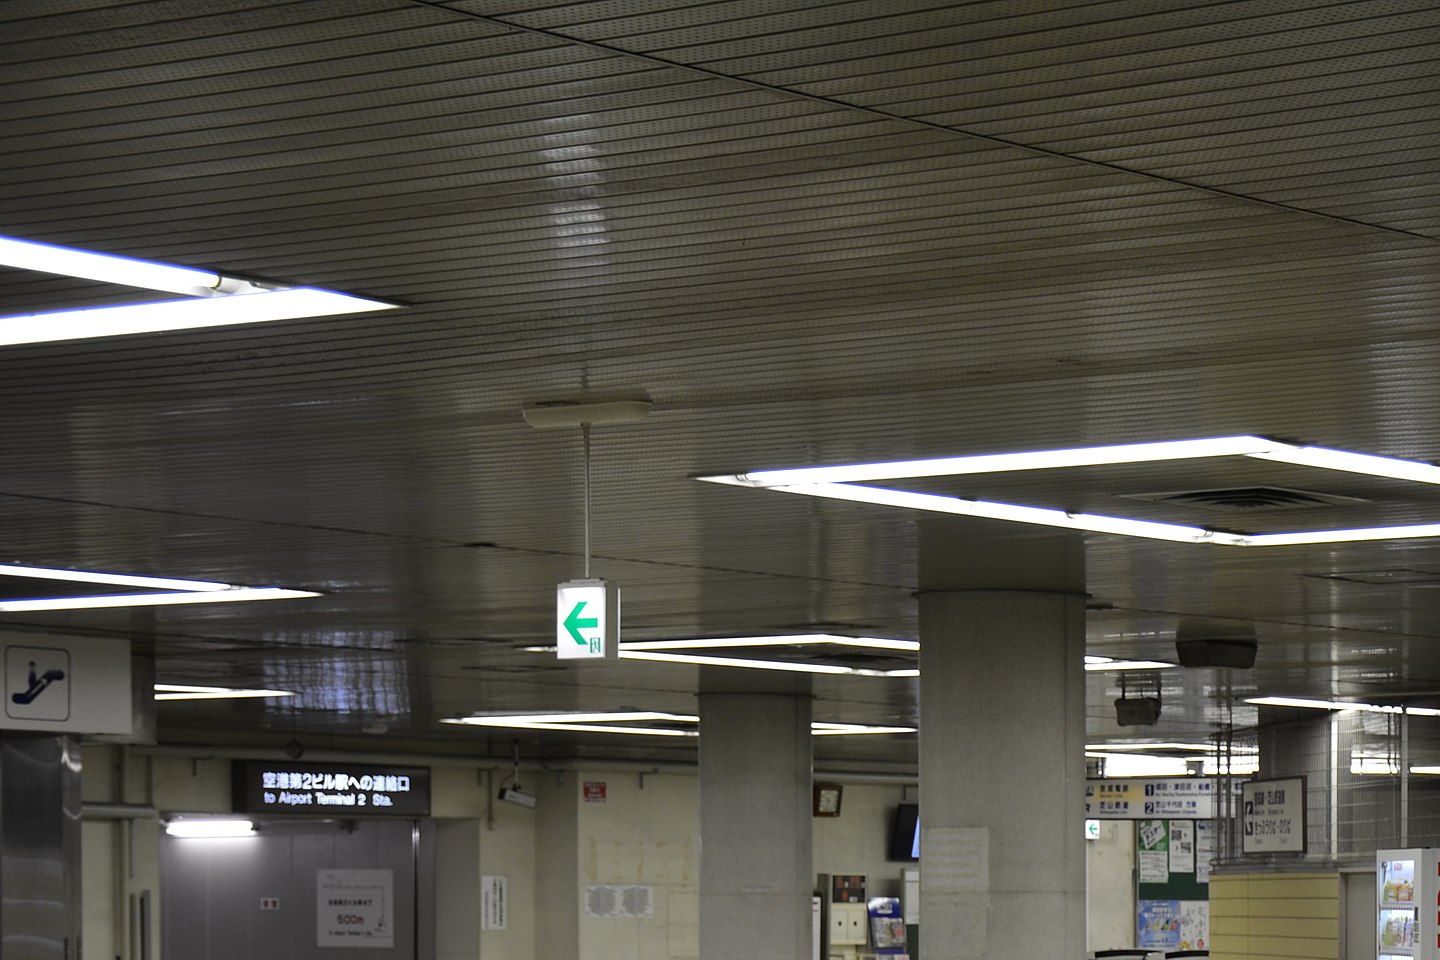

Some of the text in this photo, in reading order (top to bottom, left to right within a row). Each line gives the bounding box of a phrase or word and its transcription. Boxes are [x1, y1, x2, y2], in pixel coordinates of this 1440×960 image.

[262, 772, 410, 792] 空港第2ビル駅への連絡口
[264, 792, 393, 807] to Airport Terminal 2 Sta.
